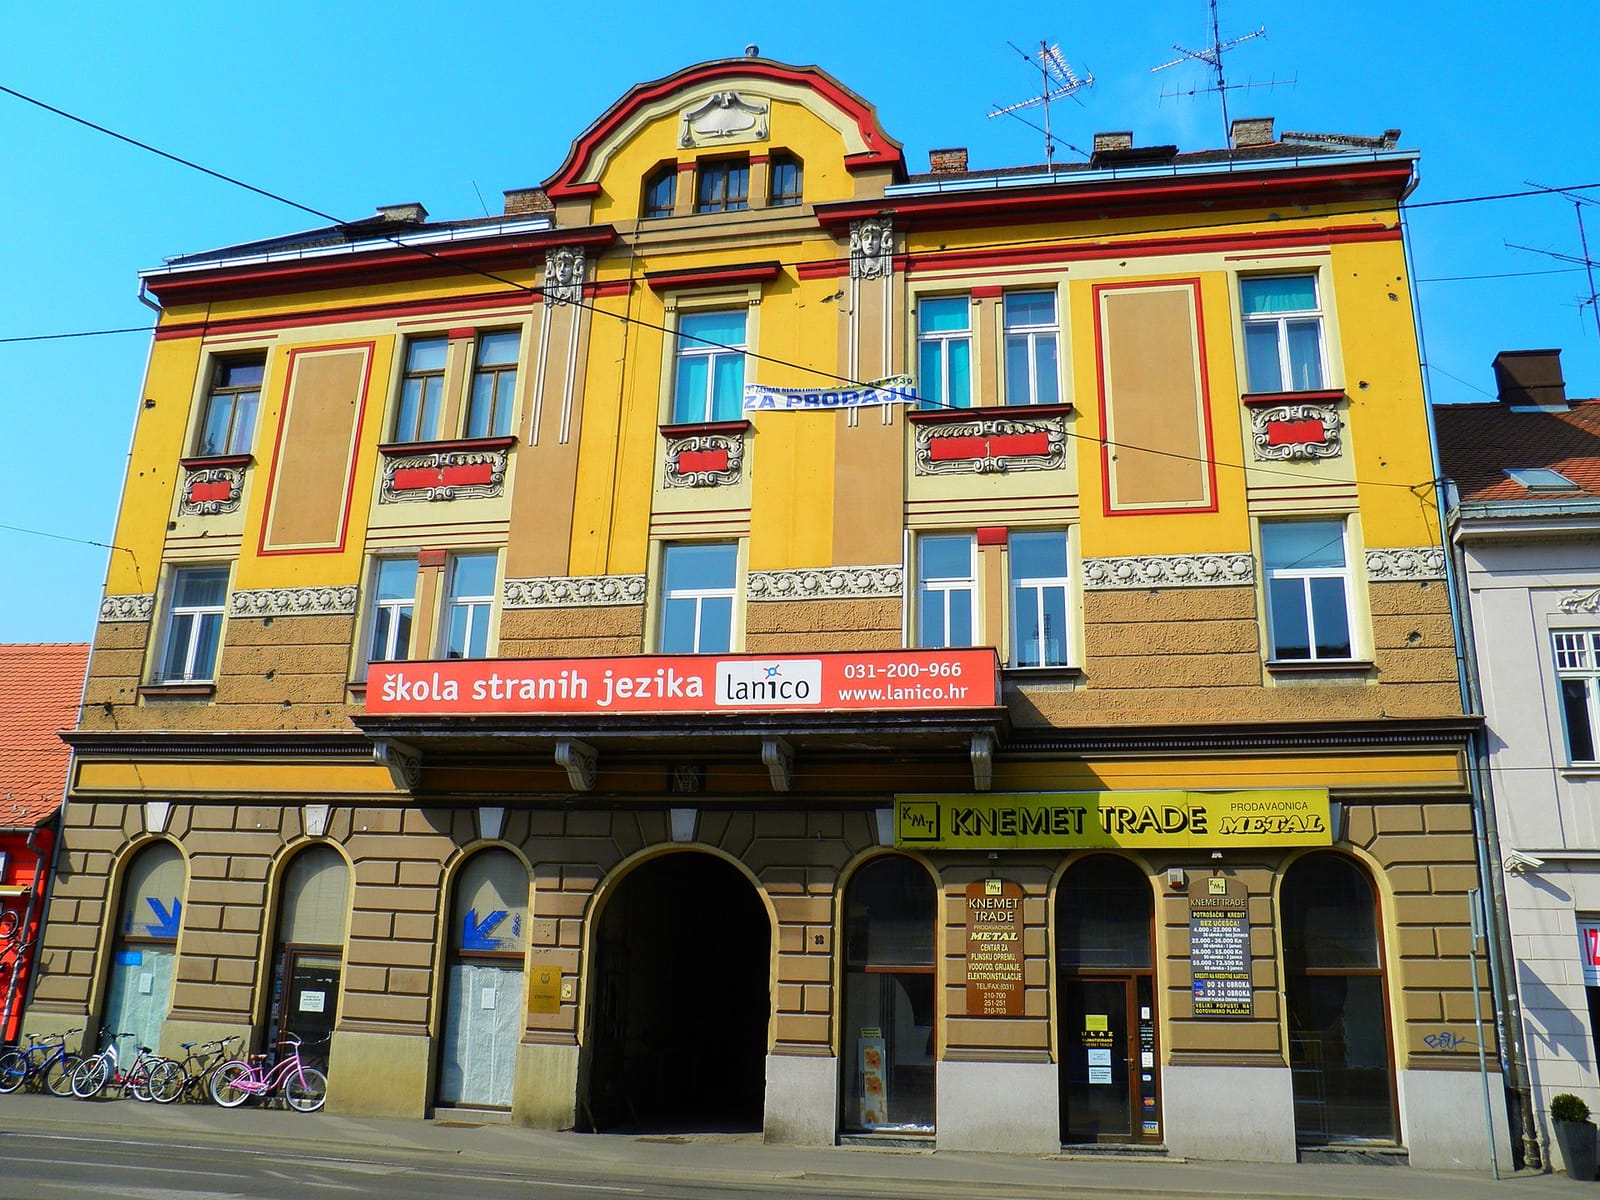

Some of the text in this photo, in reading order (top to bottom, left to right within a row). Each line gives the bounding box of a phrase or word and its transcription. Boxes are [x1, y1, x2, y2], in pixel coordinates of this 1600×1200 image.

[744, 395, 776, 409] ZA
[844, 662, 963, 679] 031-200-966
[382, 667, 704, 707] škola stranih jezika
[726, 673, 810, 700] lanico
[838, 683, 969, 701] www.lanico.hr
[1230, 801, 1309, 812] PRODAVAONICA
[951, 804, 1209, 836] KNEMET TRADE
[1219, 814, 1326, 835] METAL
[969, 898, 1019, 909] KNEMET
[1190, 898, 1246, 907] KNEMET TRADE
[974, 911, 1015, 922] TRADE
[970, 932, 1019, 941] METAL
